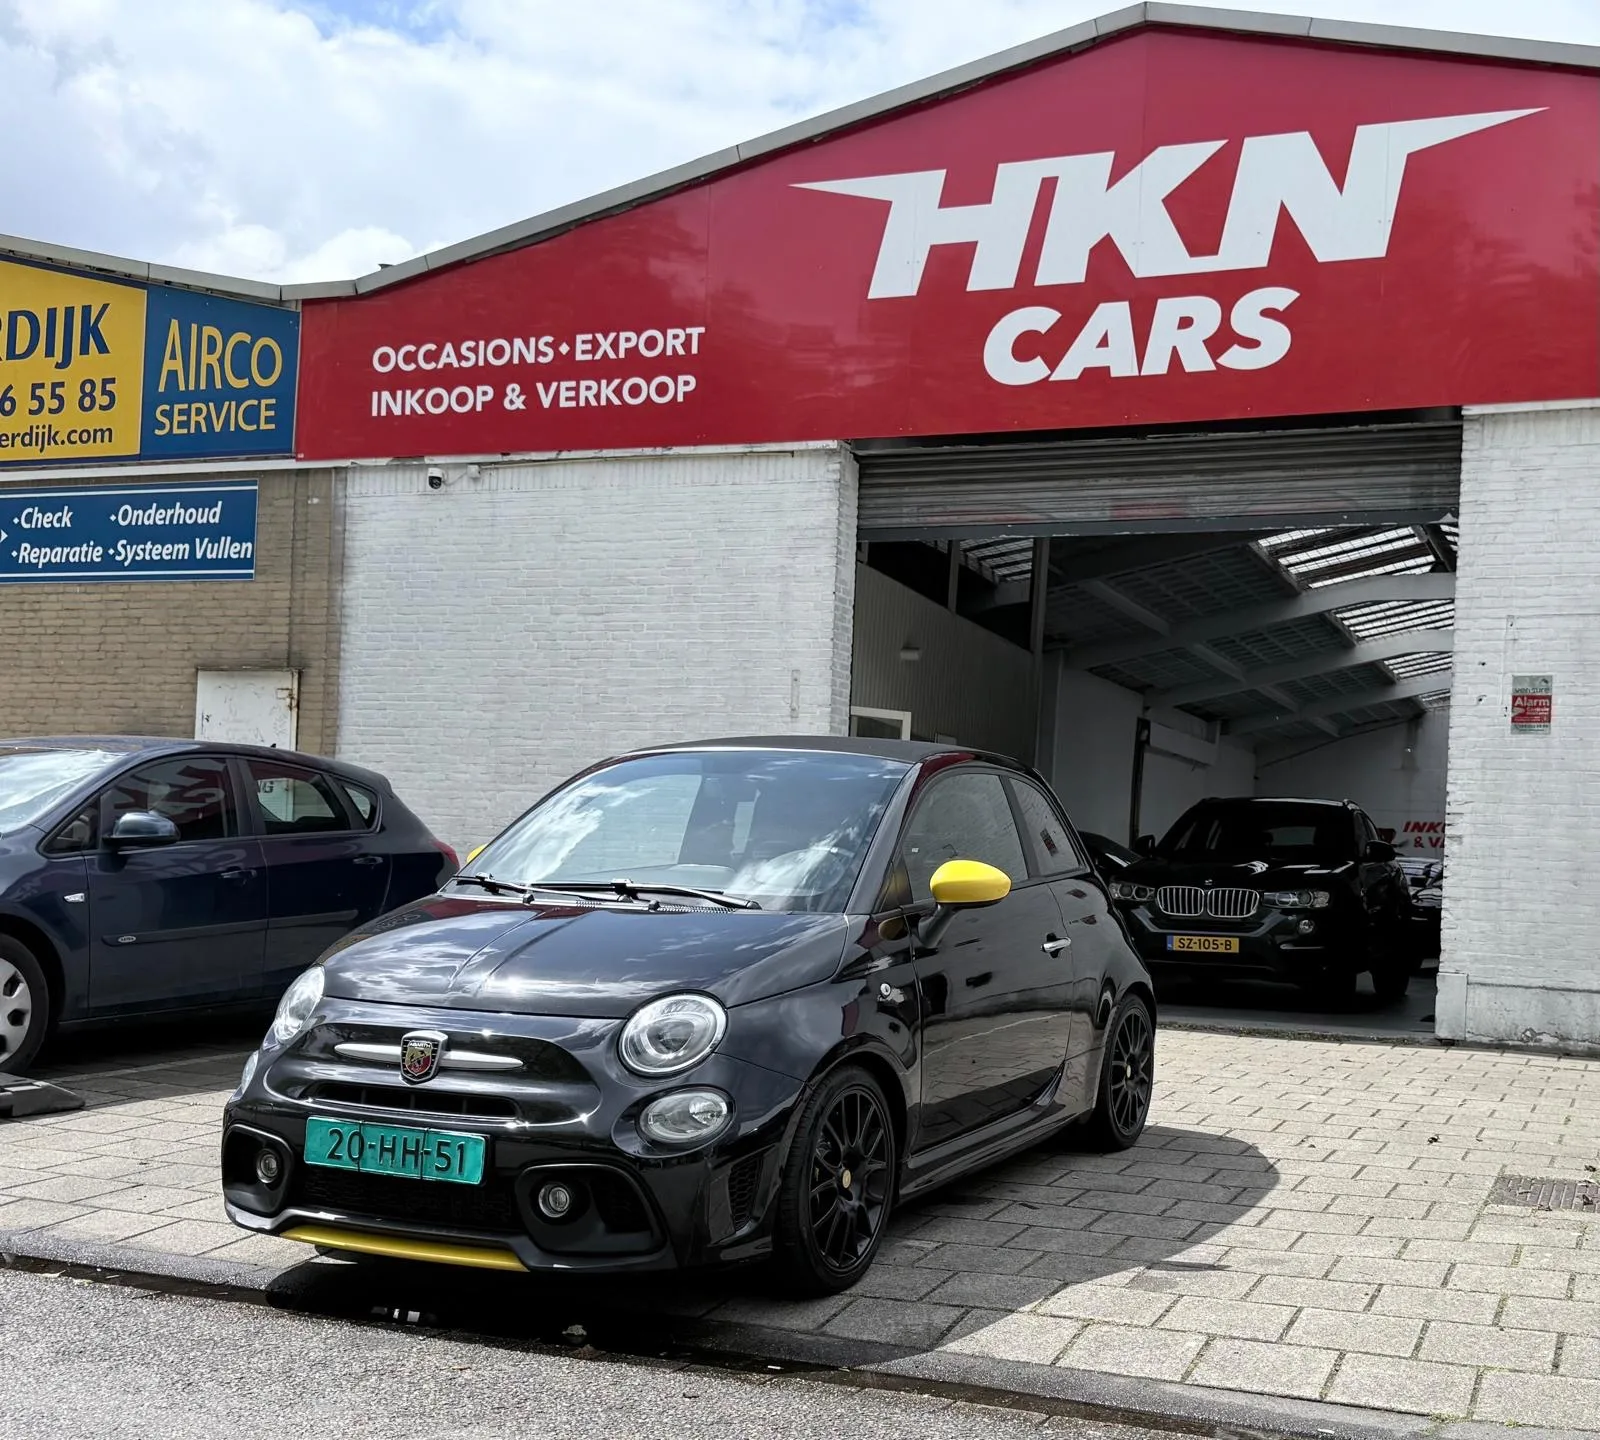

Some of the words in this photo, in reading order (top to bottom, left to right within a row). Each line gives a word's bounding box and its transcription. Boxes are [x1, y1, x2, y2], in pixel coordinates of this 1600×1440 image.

[787, 107, 1550, 300] HKN
[0, 303, 110, 370] DIJK
[158, 318, 283, 393] AIRCO
[372, 335, 554, 373] OCCASIONS
[575, 327, 706, 362] EXPORT
[983, 287, 1300, 386] CARS
[0, 384, 17, 417] 6
[28, 381, 66, 416] 55
[78, 377, 117, 413] 85
[371, 385, 494, 417] INKOOP
[503, 382, 527, 411] &
[535, 375, 697, 409] VERKOOP
[154, 398, 277, 436] SERVICE
[20, 505, 74, 529] Check
[117, 501, 223, 527] Onderhoud
[18, 541, 103, 568] Reparatie
[115, 539, 189, 567] Systeem
[195, 536, 253, 560] Vullen
[1514, 696, 1550, 707] Alarm
[1413, 836, 1425, 849] &
[1177, 937, 1233, 951] SZ-105-B
[326, 1127, 466, 1176] 20-HH-51
